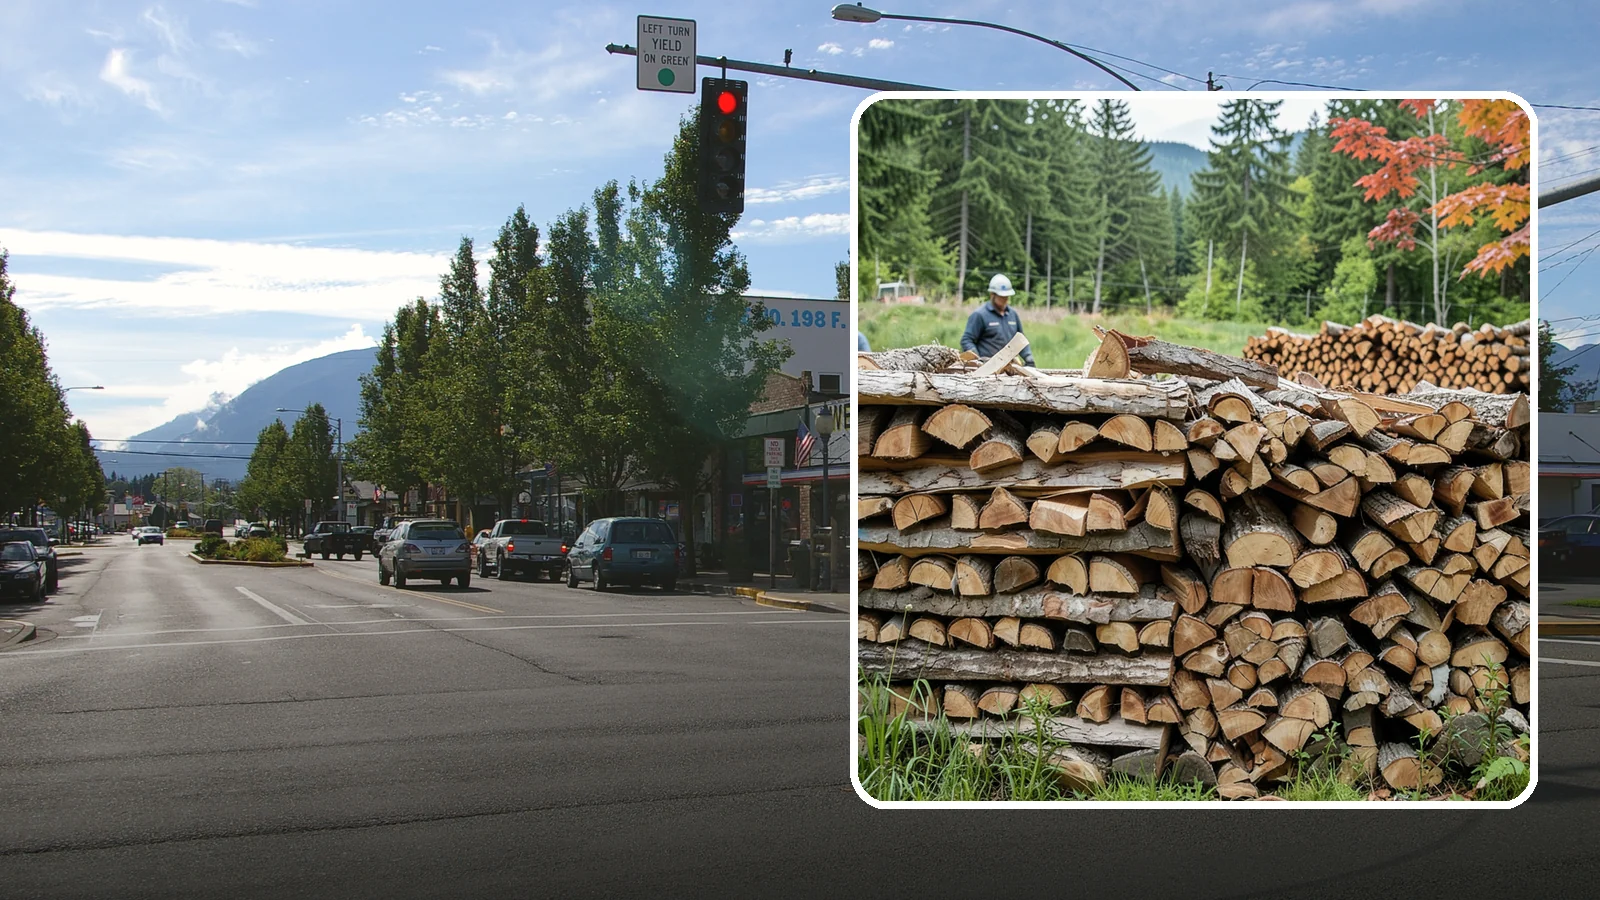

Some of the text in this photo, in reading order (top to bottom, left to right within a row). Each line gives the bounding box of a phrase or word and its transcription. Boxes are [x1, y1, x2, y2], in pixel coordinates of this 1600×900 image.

[643, 23, 690, 36] LEFT TURN
[652, 38, 682, 52] YIELD
[644, 53, 688, 66] ON GREEN
[791, 309, 826, 328] 198
[831, 311, 847, 329] F.
